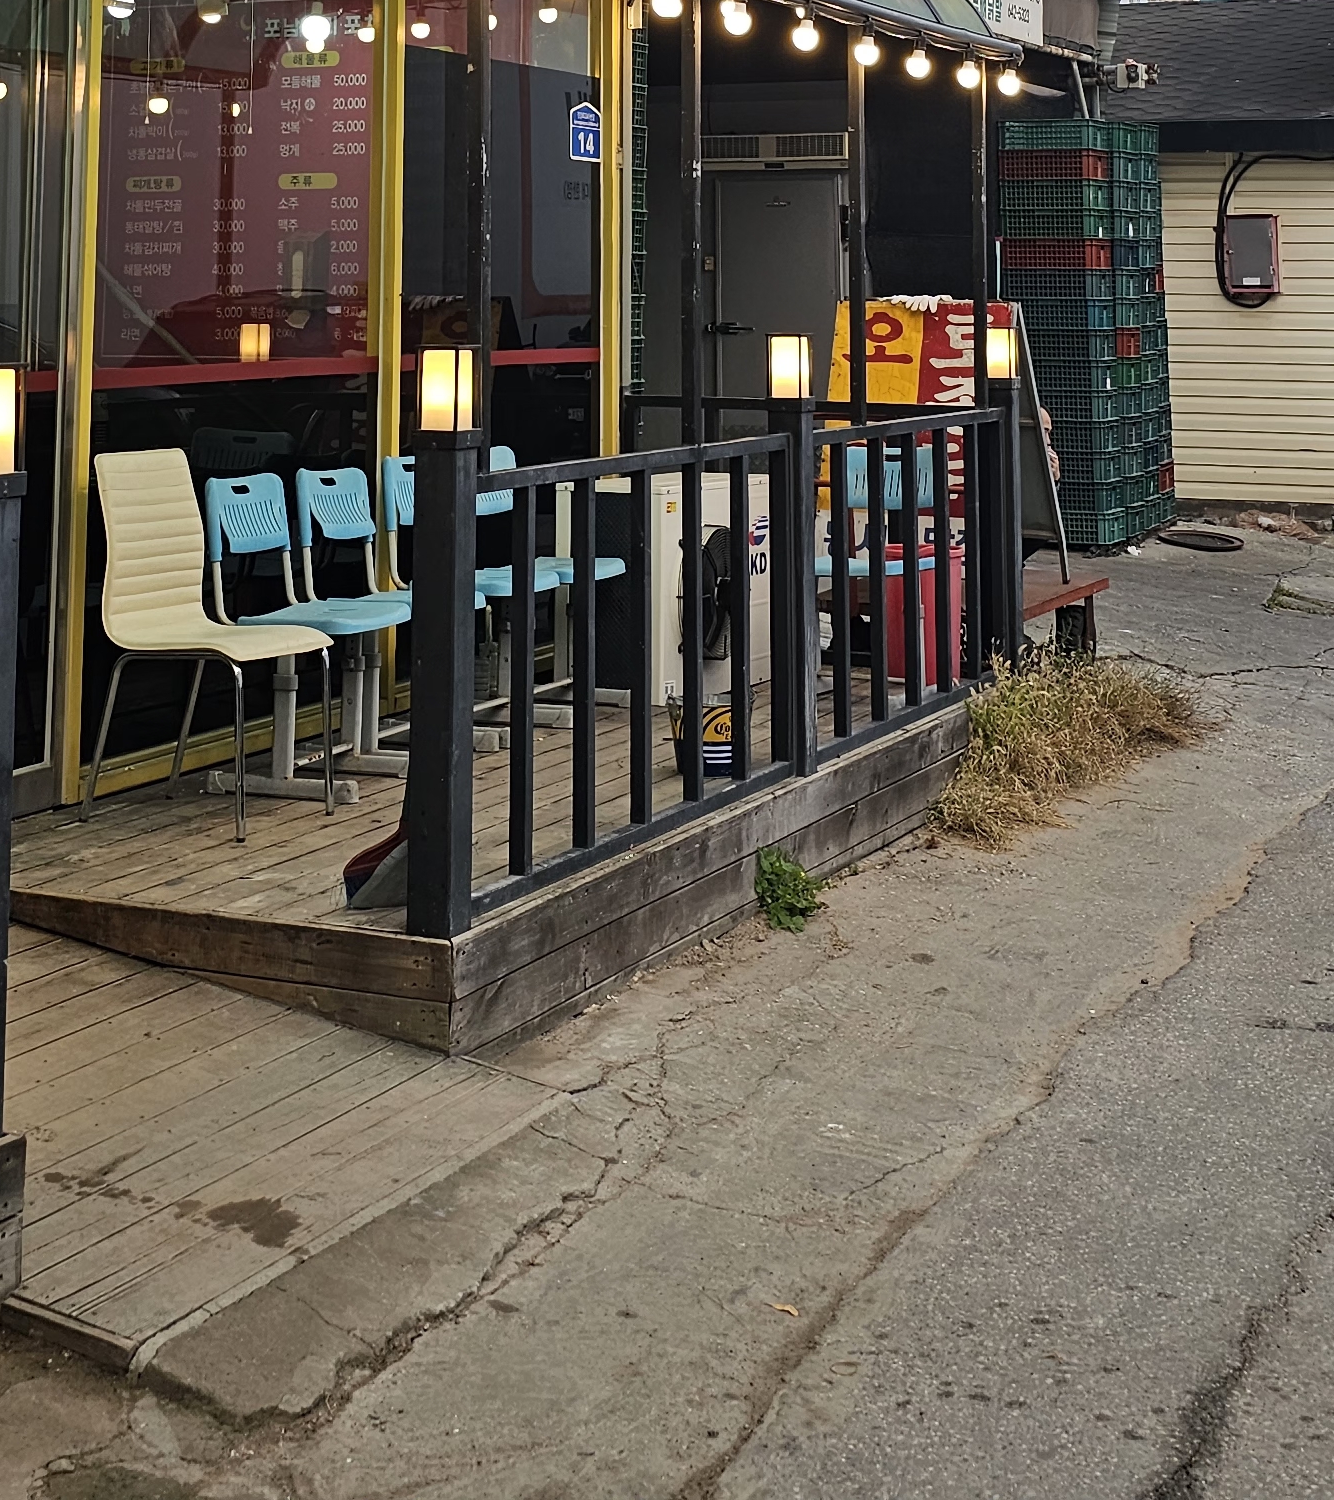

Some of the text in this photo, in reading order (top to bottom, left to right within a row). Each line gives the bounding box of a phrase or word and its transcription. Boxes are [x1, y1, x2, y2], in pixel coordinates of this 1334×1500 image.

[333, 73, 367, 86] 50,000
[332, 97, 367, 111] 20,000
[217, 123, 247, 138] 13,000
[279, 120, 366, 135] 전복 25,000
[577, 131, 595, 155] 14
[217, 145, 247, 158] 13,000
[279, 142, 366, 158] 멍게 25,000
[289, 174, 313, 187] 주류
[213, 198, 246, 211] 30,000
[277, 196, 359, 210] 소주 5,000
[212, 220, 245, 232] 30,000
[330, 219, 358, 231] 5,000
[212, 241, 245, 253] 30,000
[330, 240, 358, 253] 2,000
[211, 263, 244, 275] 40,000
[330, 263, 359, 274] 6,000
[216, 285, 244, 297] 4,000
[330, 285, 359, 297] 4,000
[216, 306, 243, 318] 5,000
